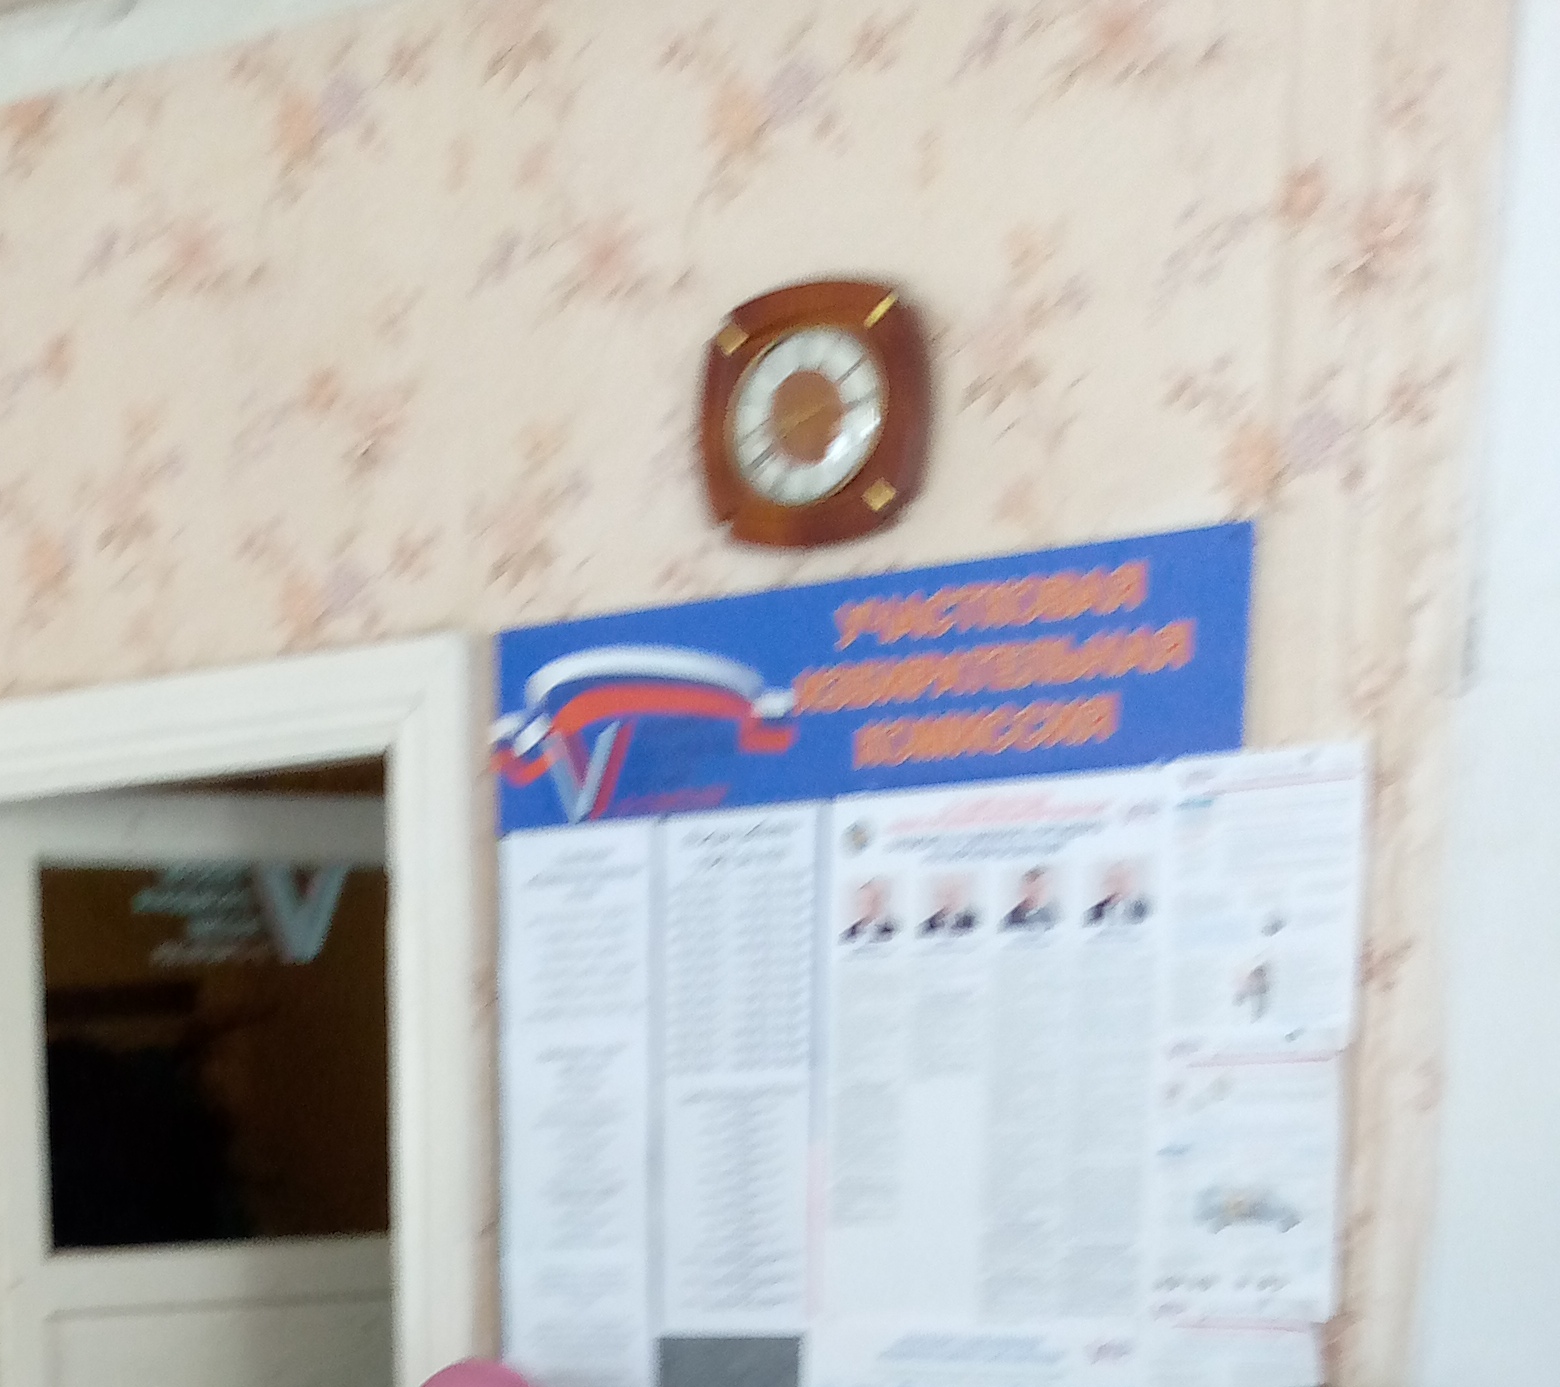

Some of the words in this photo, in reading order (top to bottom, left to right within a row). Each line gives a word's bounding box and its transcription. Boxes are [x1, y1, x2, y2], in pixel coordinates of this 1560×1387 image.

[836, 560, 1148, 651] УЧАСТКОВАЯ
[794, 620, 1195, 715] ИЗБИРАТЕЛЬНАЯ
[853, 693, 1122, 770] КОМИССИЯ
